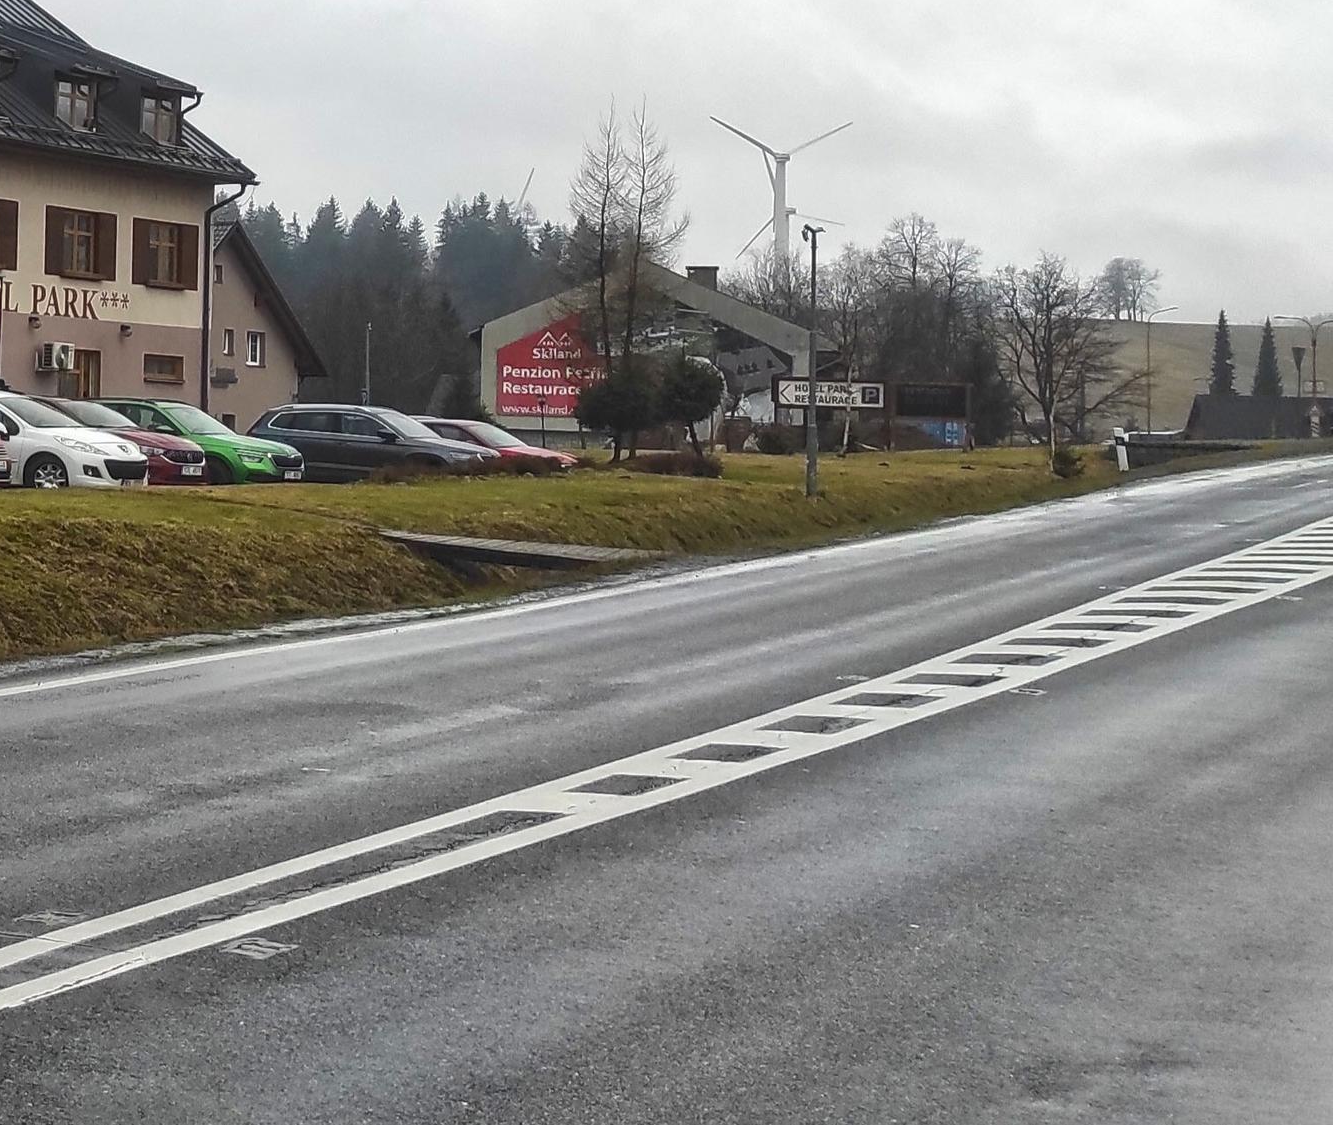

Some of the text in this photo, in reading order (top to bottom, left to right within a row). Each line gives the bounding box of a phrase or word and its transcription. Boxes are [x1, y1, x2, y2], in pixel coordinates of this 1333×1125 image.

[532, 347, 581, 359] Skiland
[503, 365, 561, 379] Penzion
[503, 382, 581, 396] Restaurace
